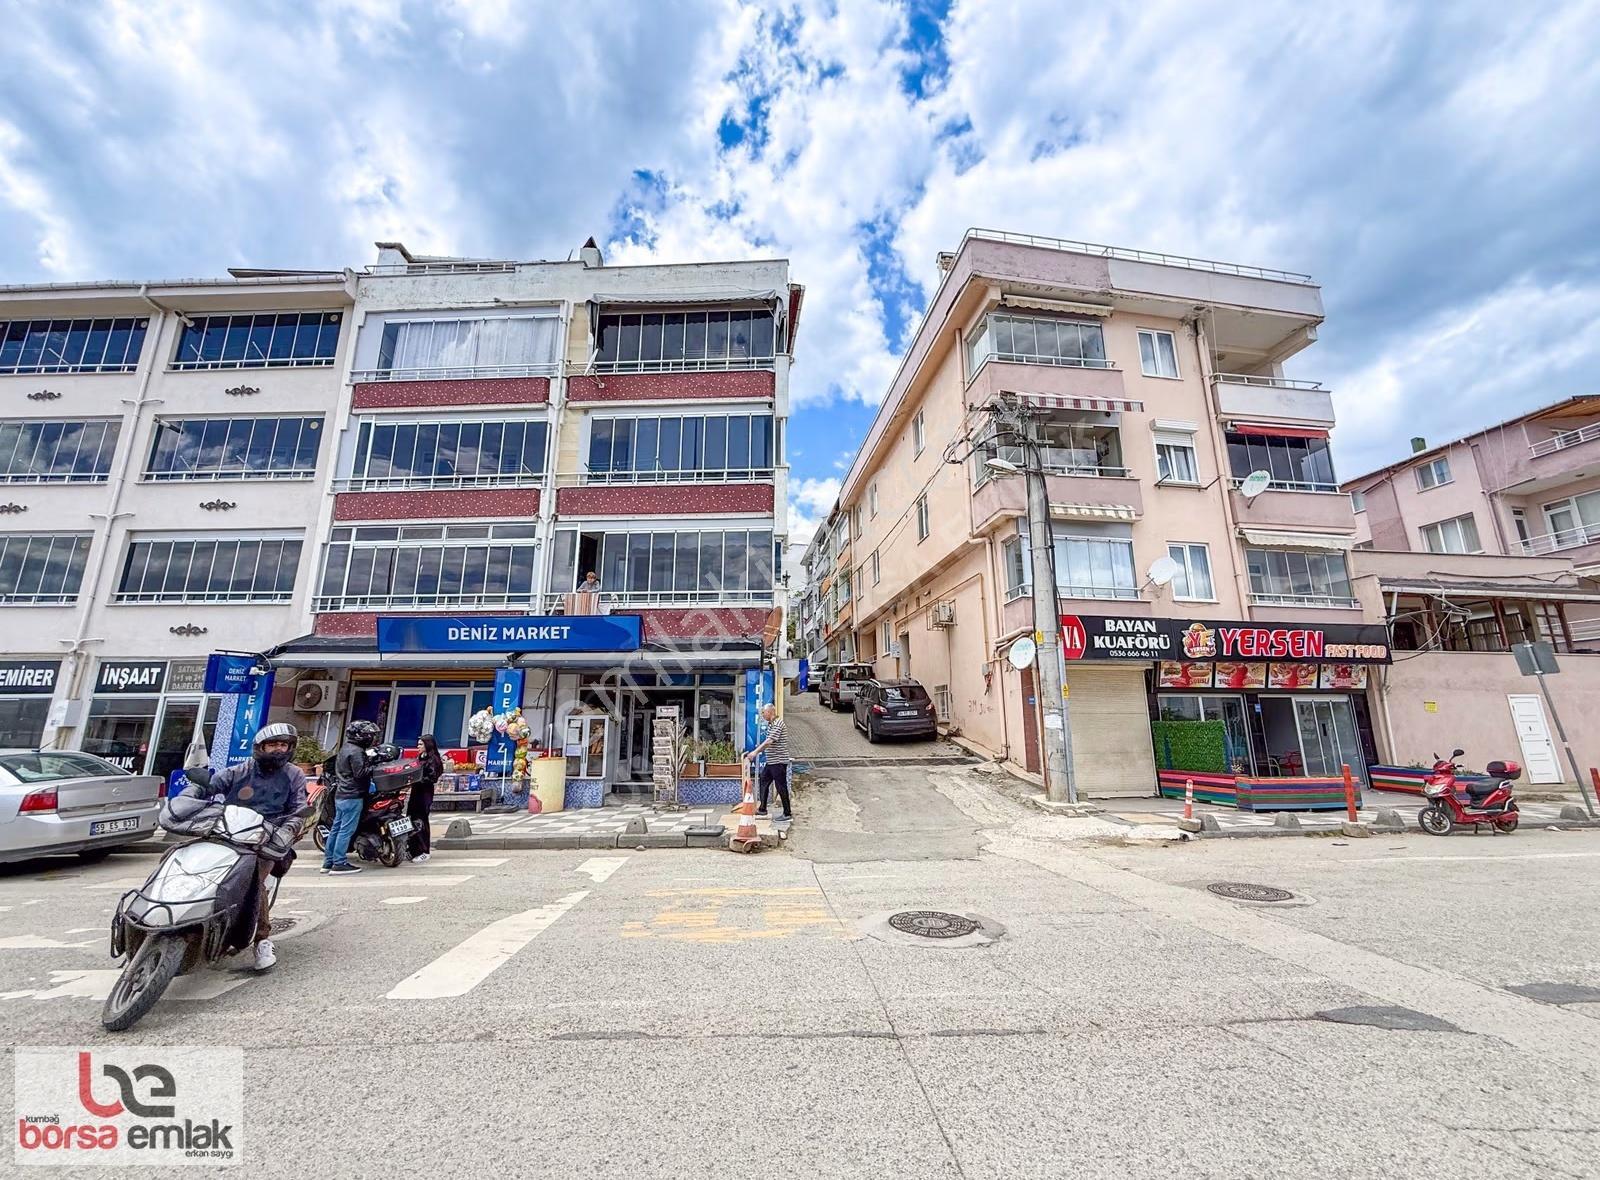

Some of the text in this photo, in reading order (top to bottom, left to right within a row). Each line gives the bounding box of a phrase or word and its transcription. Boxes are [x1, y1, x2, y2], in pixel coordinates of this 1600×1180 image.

[448, 624, 570, 640] DENİZ MARKET
[1104, 619, 1157, 633] BAYAN
[1061, 626, 1082, 649] VA
[1093, 634, 1171, 649] KUAFÖRÜ
[1218, 628, 1324, 658] YERSEN
[1325, 644, 1387, 659] FAST FOOD
[0, 665, 54, 686] EMİRER
[102, 664, 161, 690] İNŞAAT
